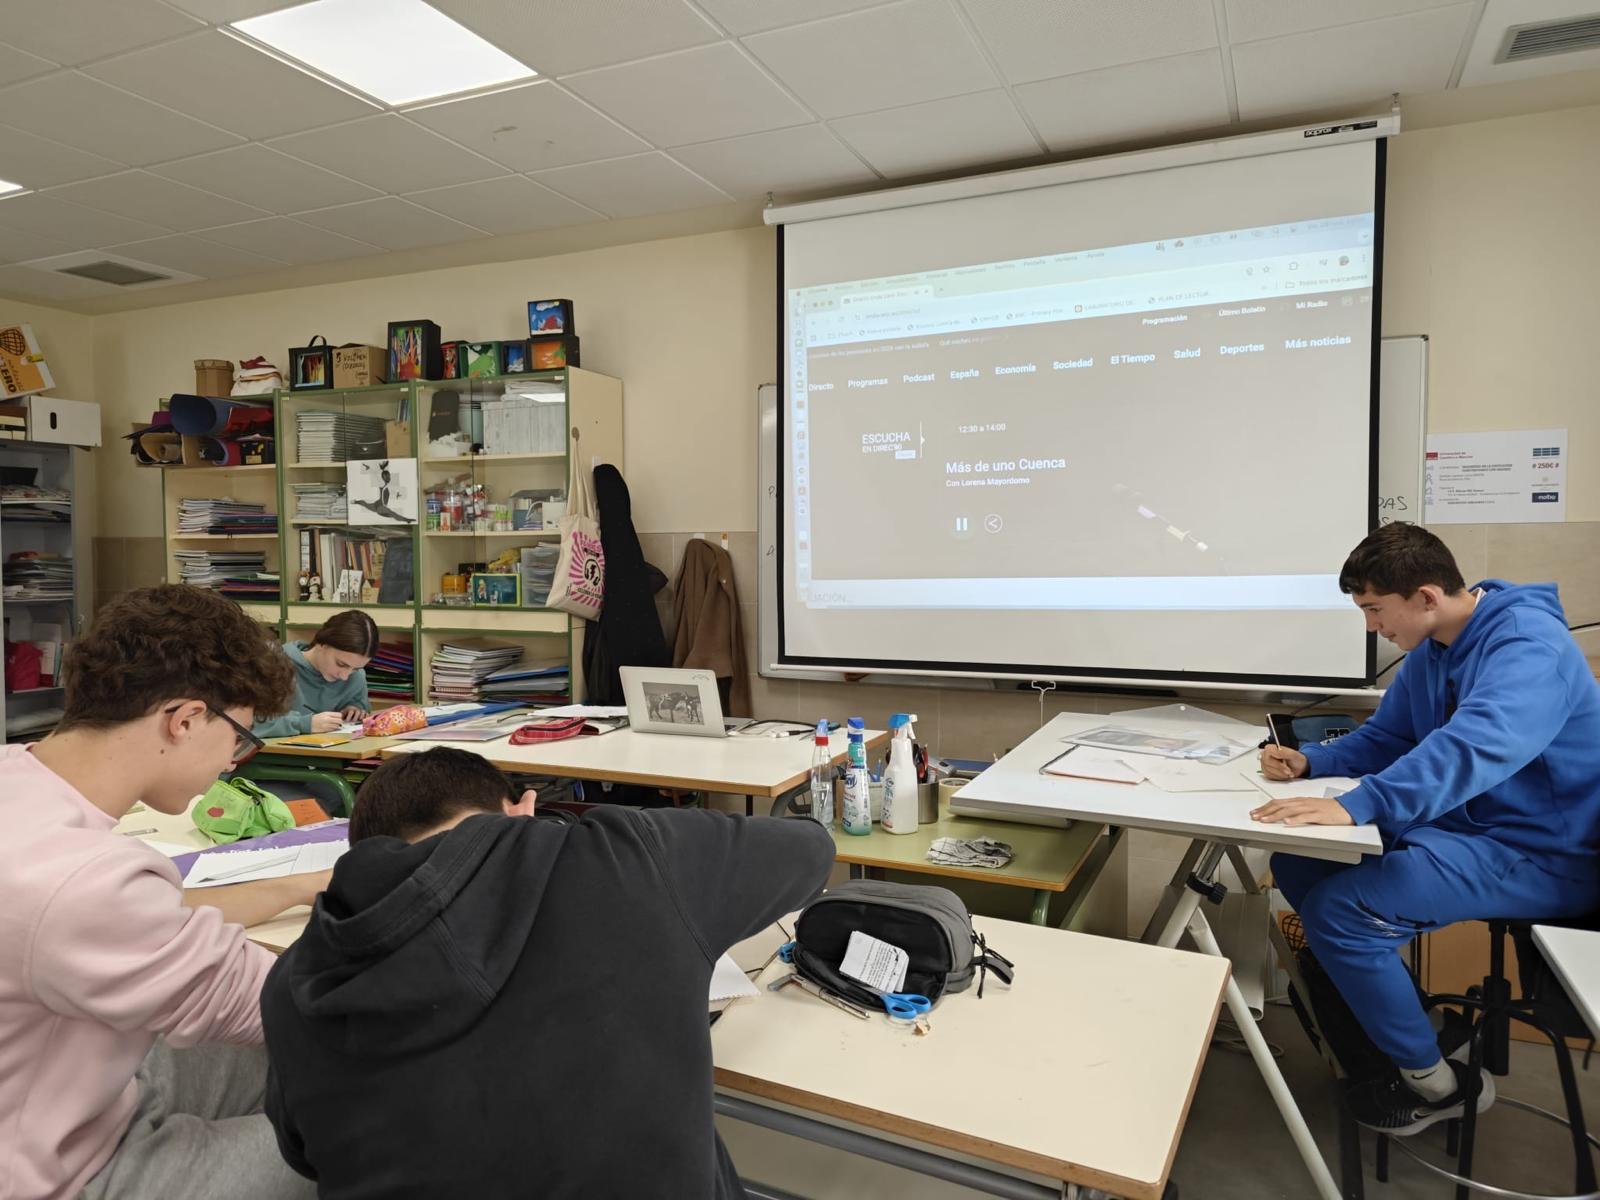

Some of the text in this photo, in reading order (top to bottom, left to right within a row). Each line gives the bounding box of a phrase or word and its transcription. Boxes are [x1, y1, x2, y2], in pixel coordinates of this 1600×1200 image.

[1307, 299, 1328, 309] Radio
[1142, 313, 1188, 326] Programación
[1219, 341, 1265, 356] Deportes
[1285, 334, 1351, 350] Más noticias
[1110, 352, 1156, 366] El Tiempo
[1173, 347, 1201, 360] Salud
[995, 362, 1037, 376] Economía
[1053, 357, 1094, 370] Sociedad
[903, 372, 935, 384] Podcast
[950, 368, 980, 380] España
[808, 382, 834, 392] Directo
[847, 376, 888, 389] Programas
[986, 423, 1006, 432] 14:00
[862, 431, 911, 444] ESCUCHA
[862, 444, 872, 453] EN
[946, 457, 1066, 474] Más de uno Cuenca
[946, 476, 1030, 487] Con Lorena Mayordomo
